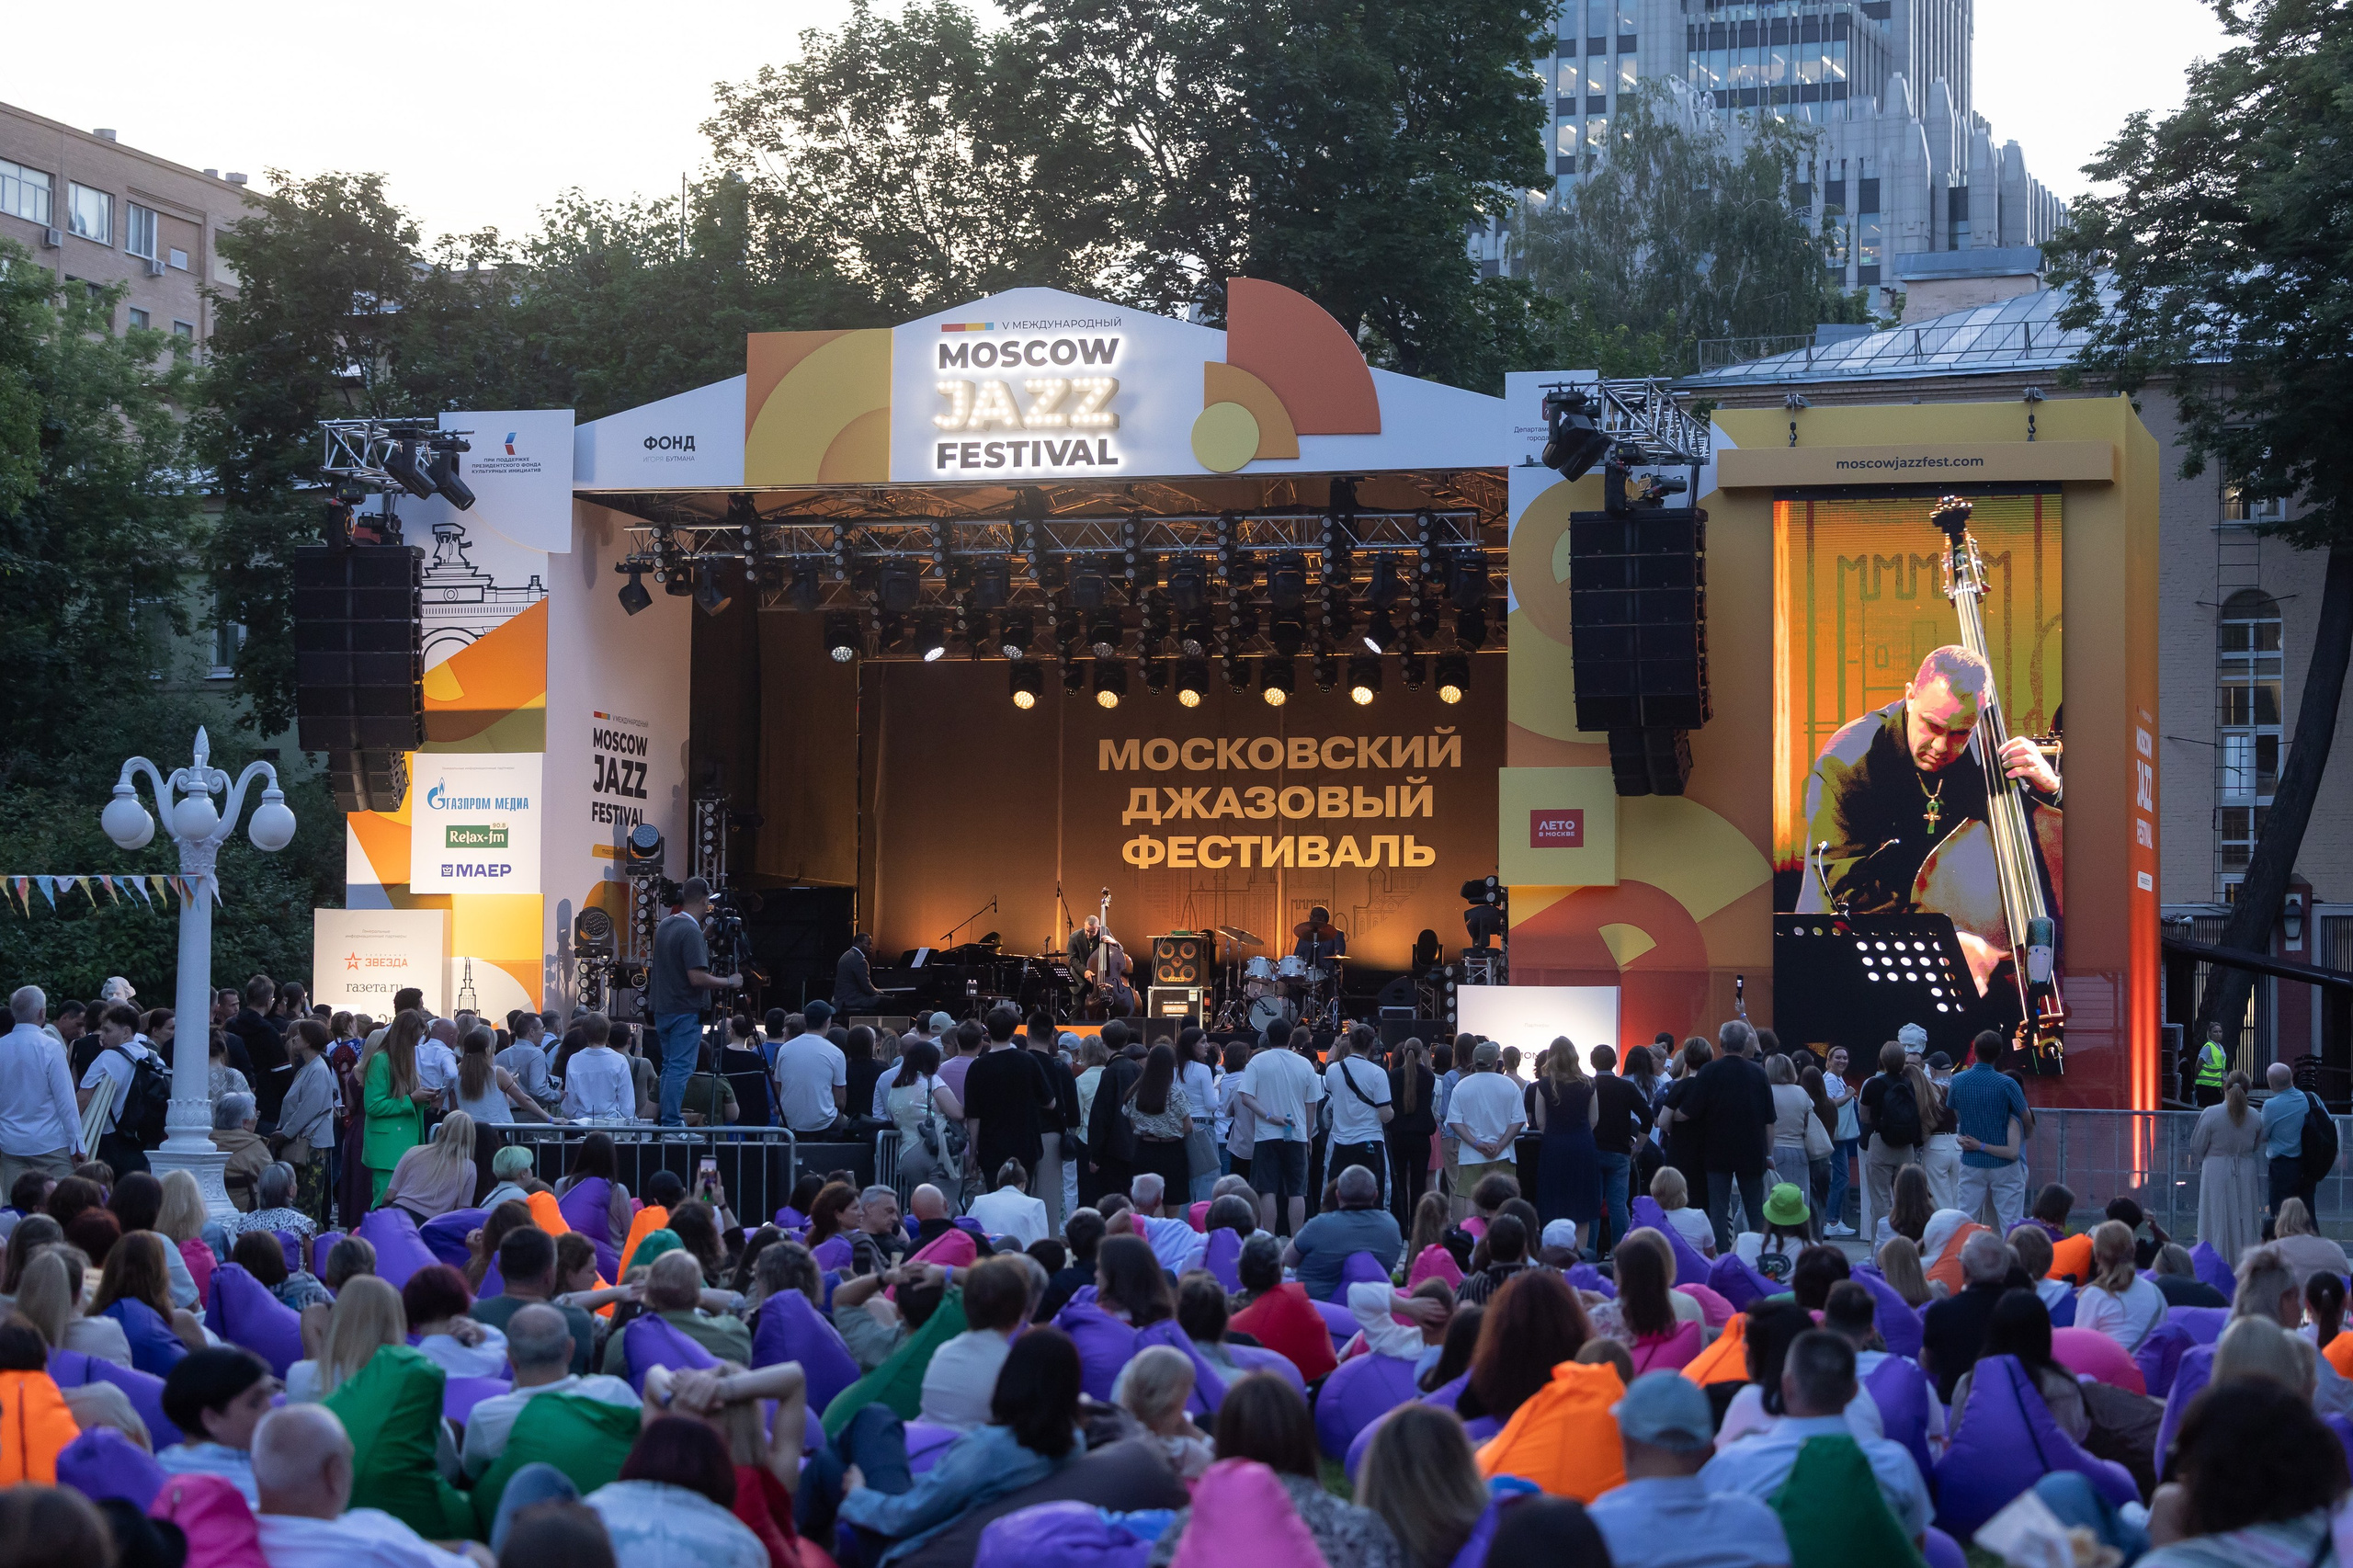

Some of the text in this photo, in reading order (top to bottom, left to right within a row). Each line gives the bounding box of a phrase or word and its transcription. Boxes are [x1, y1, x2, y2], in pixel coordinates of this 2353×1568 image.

[1012, 316, 1122, 331] МЕЖДУНАРОДНЫЙ
[938, 338, 1120, 369] MOSCOW
[933, 377, 1120, 431] JAZZ
[643, 436, 696, 451] ФОНД
[937, 438, 1119, 469] FESTIVAL
[1836, 457, 1984, 471] moscowjazzfest.com
[593, 727, 648, 756] MOSCOW
[1098, 726, 1461, 770] МОСКОВСКИЙ
[593, 754, 648, 800] JAZZ
[446, 797, 529, 812] ГАЗПРОМ МЕДИА
[1121, 776, 1434, 825] ДЖАЗОВЫЙ
[592, 801, 643, 827] FESTIVAL
[1539, 820, 1575, 830] ЛЕТО
[449, 830, 505, 844] Relax-fm
[1121, 834, 1436, 869] ФЕСТИВАЛЬ
[456, 864, 512, 877] МАЕР
[365, 958, 408, 968] ЗВЕЗДА
[346, 983, 404, 993] газета.ru
